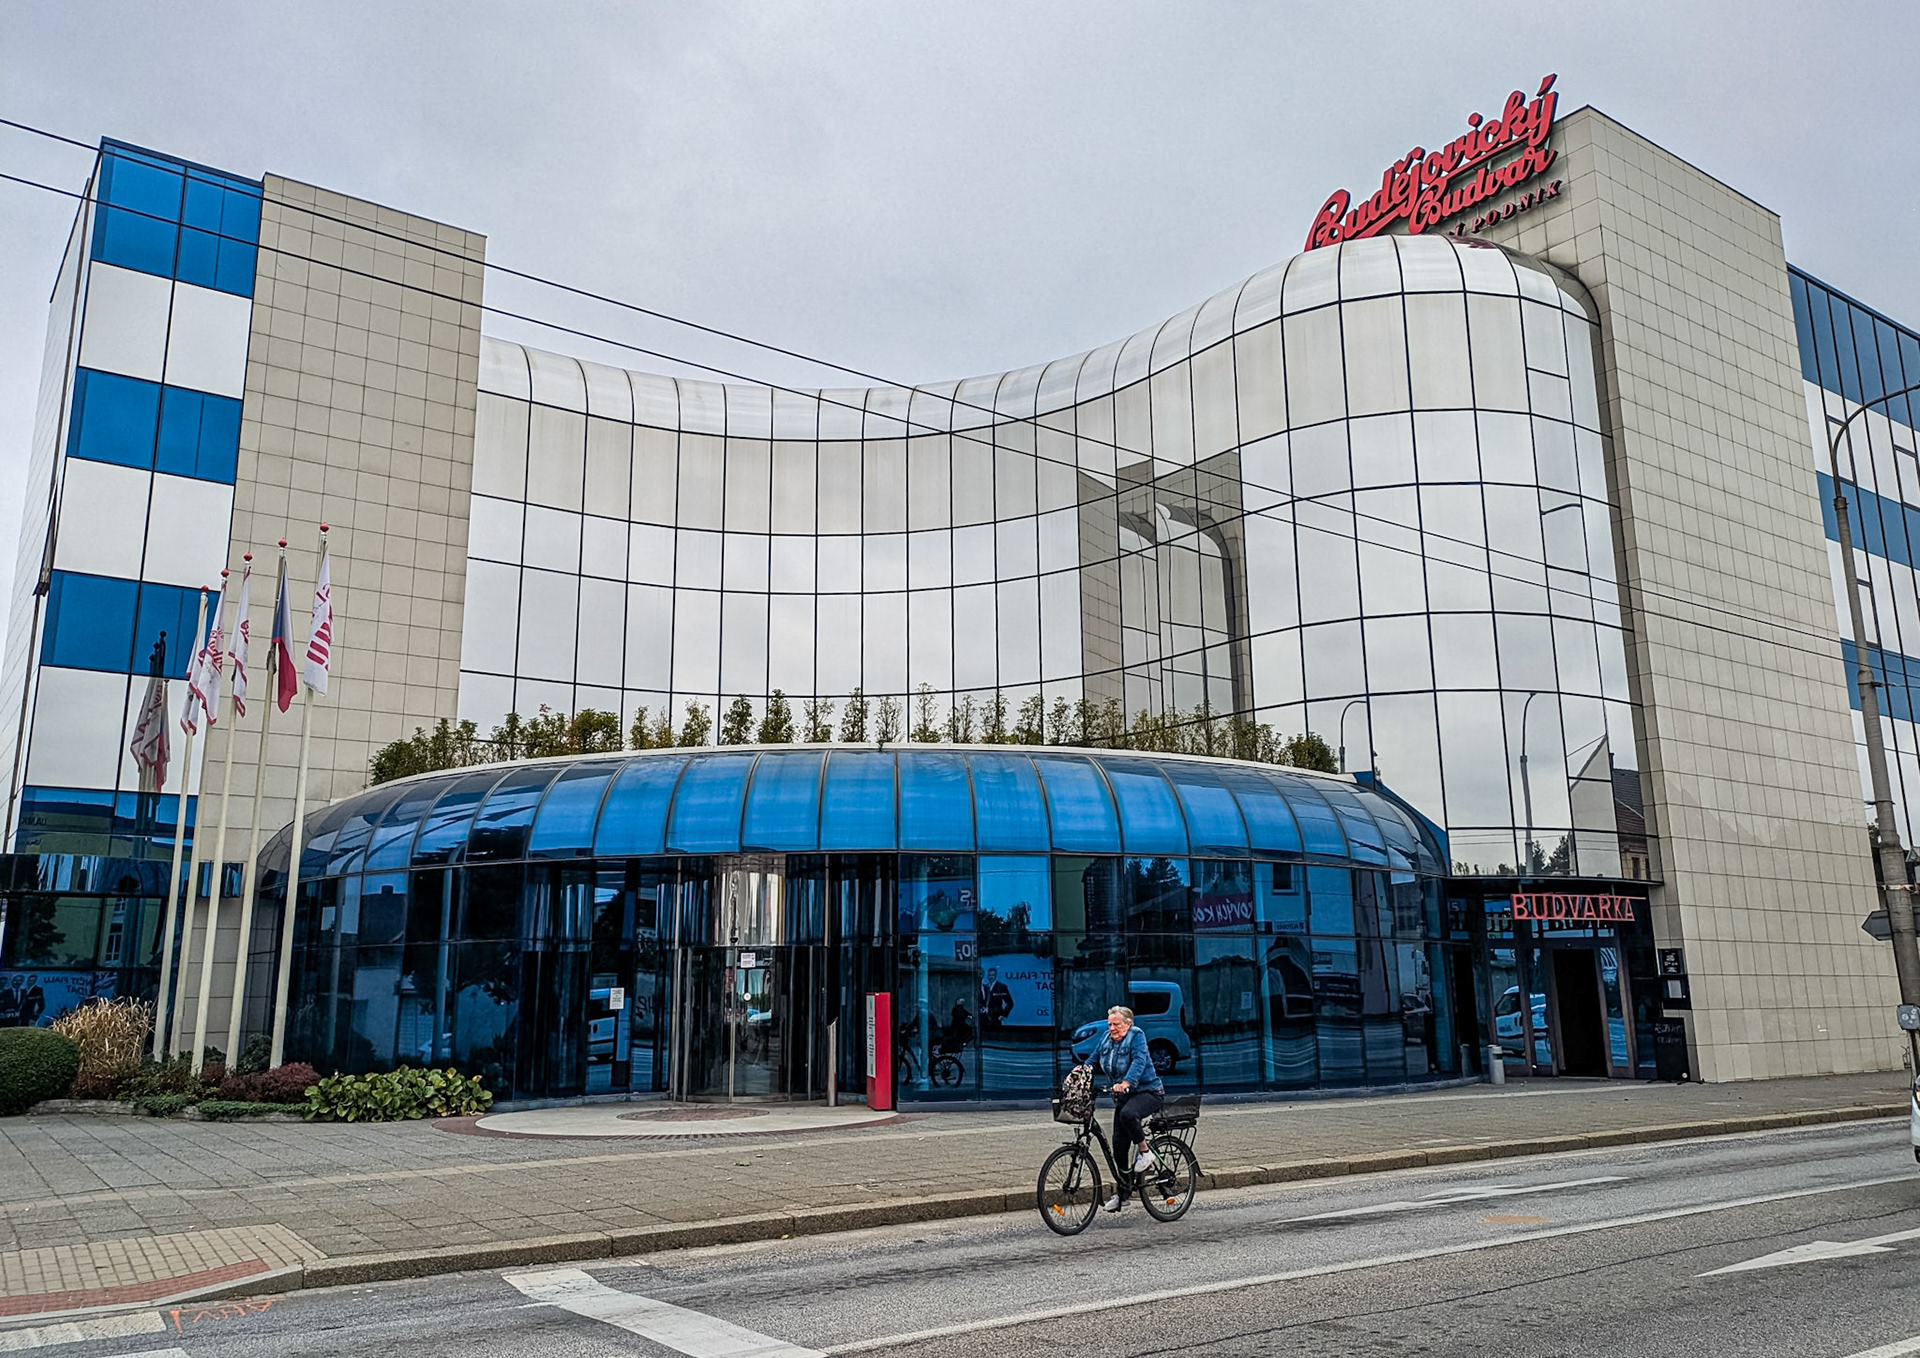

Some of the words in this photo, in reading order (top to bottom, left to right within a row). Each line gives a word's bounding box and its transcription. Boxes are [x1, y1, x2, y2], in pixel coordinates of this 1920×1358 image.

[1305, 73, 1559, 251] Budějovický
[1408, 146, 1558, 235] Budvar
[1471, 179, 1562, 234] PODNIK
[1511, 893, 1635, 921] BUDVARKA
